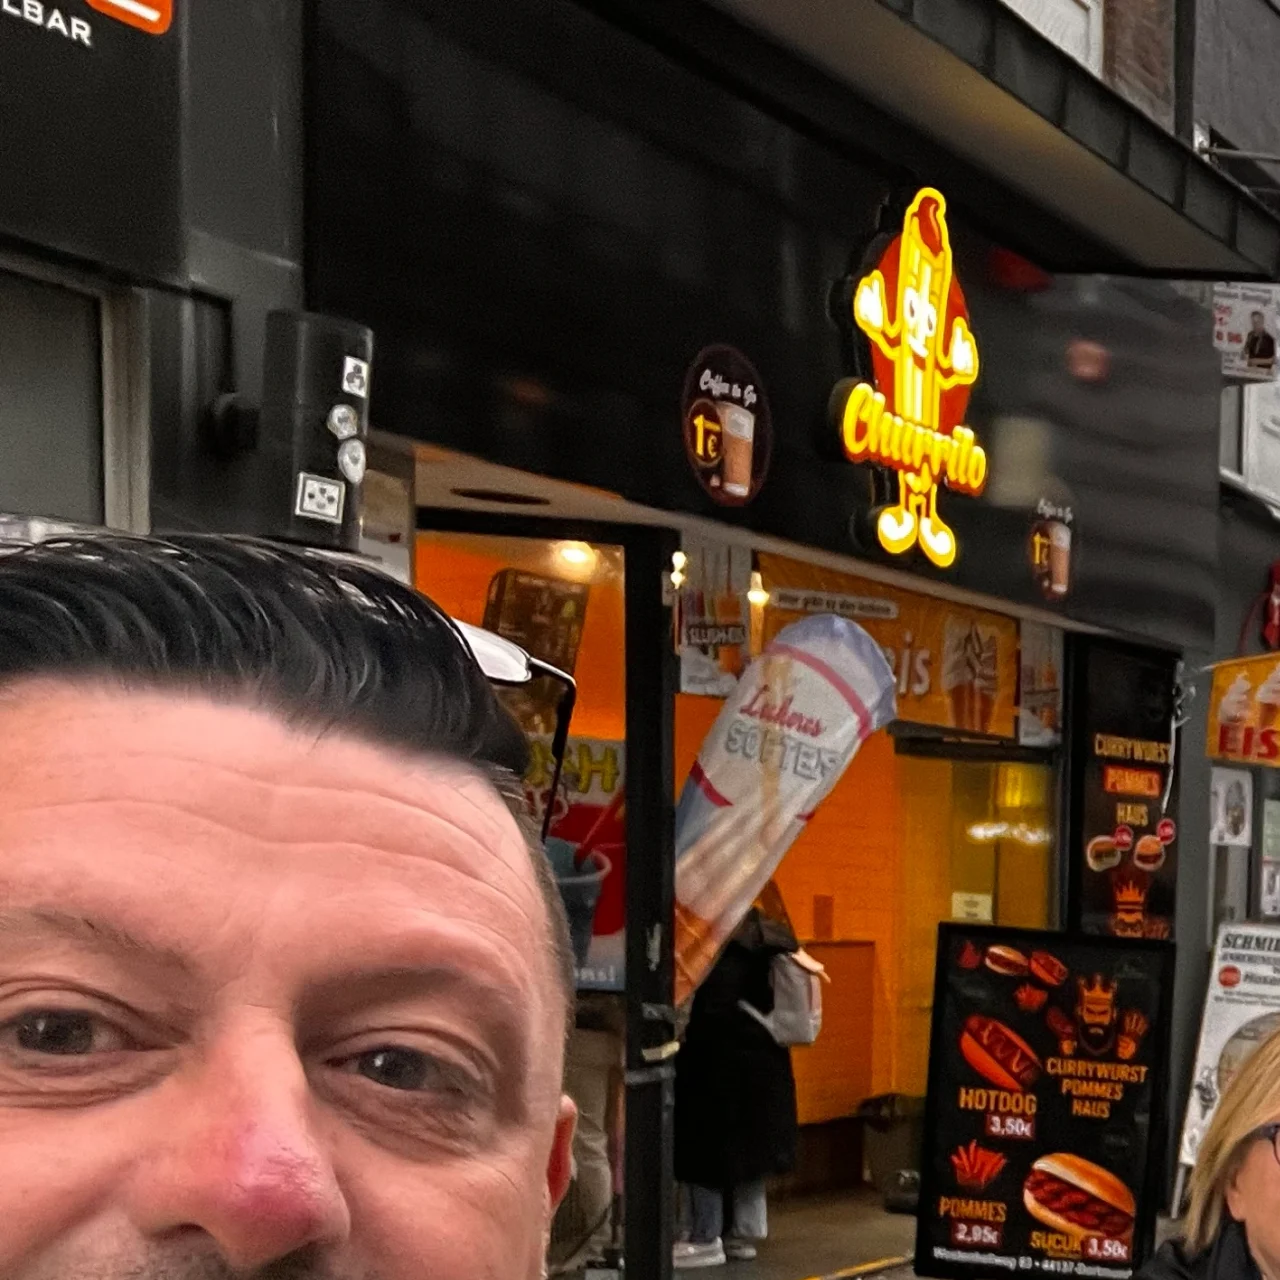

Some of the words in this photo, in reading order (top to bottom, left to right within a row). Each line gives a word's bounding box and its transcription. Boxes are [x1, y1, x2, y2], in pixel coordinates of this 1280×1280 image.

[1116, 802, 1149, 827] HAUS
[1046, 1057, 1149, 1084] CURRYWURST
[959, 1086, 1038, 1116] HOTDOG
[1061, 1078, 1123, 1101] POMMES
[1072, 1100, 1110, 1118] HAUS
[939, 1196, 1007, 1223] POMMES
[1031, 1231, 1082, 1252] SUCUK
